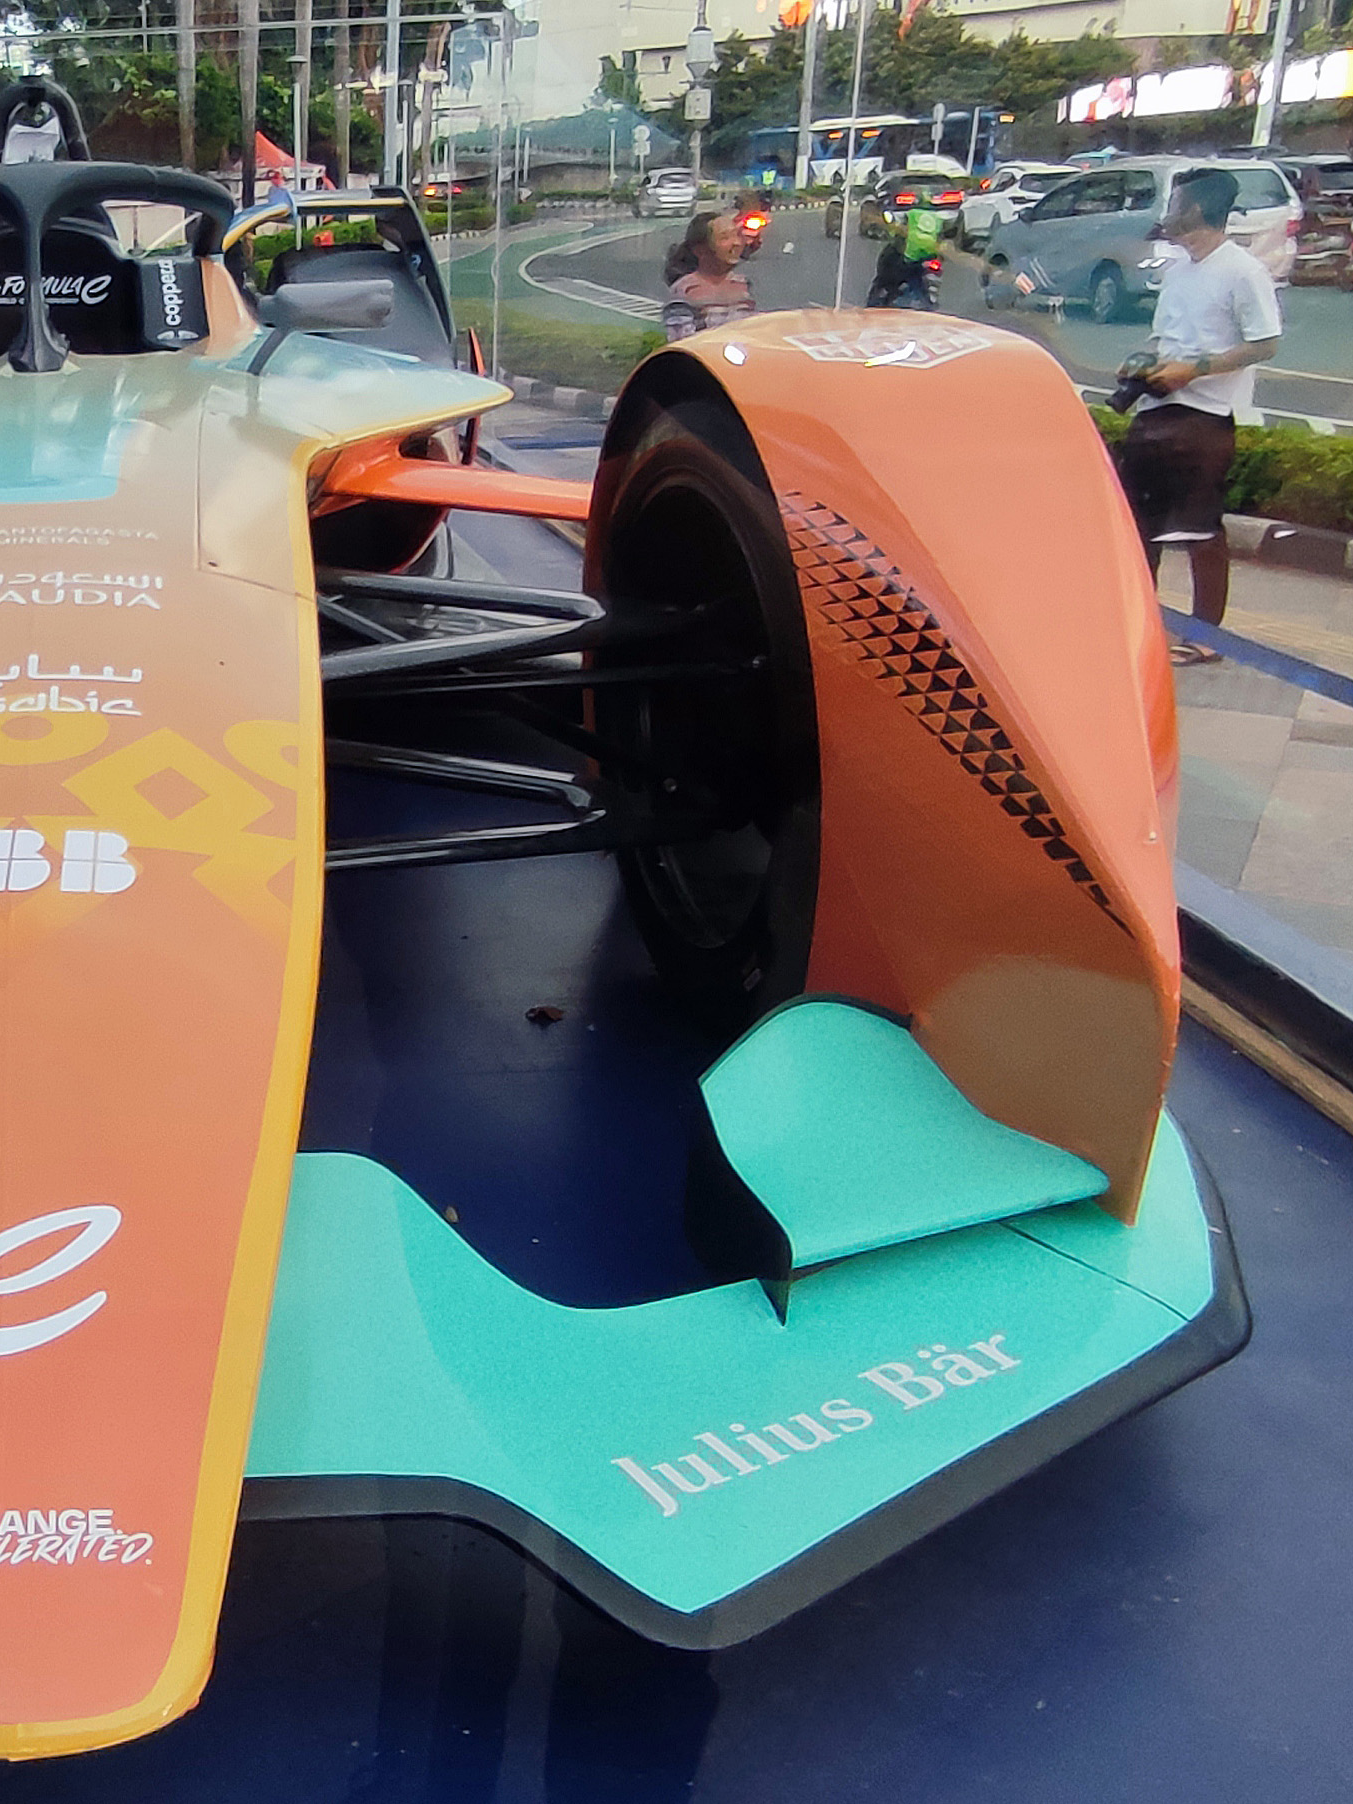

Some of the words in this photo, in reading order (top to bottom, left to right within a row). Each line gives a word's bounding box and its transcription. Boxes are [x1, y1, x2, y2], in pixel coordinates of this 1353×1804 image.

[2, 275, 85, 296] FOMULA
[610, 1398, 875, 1518] Julius
[856, 1334, 1022, 1411] Bär
